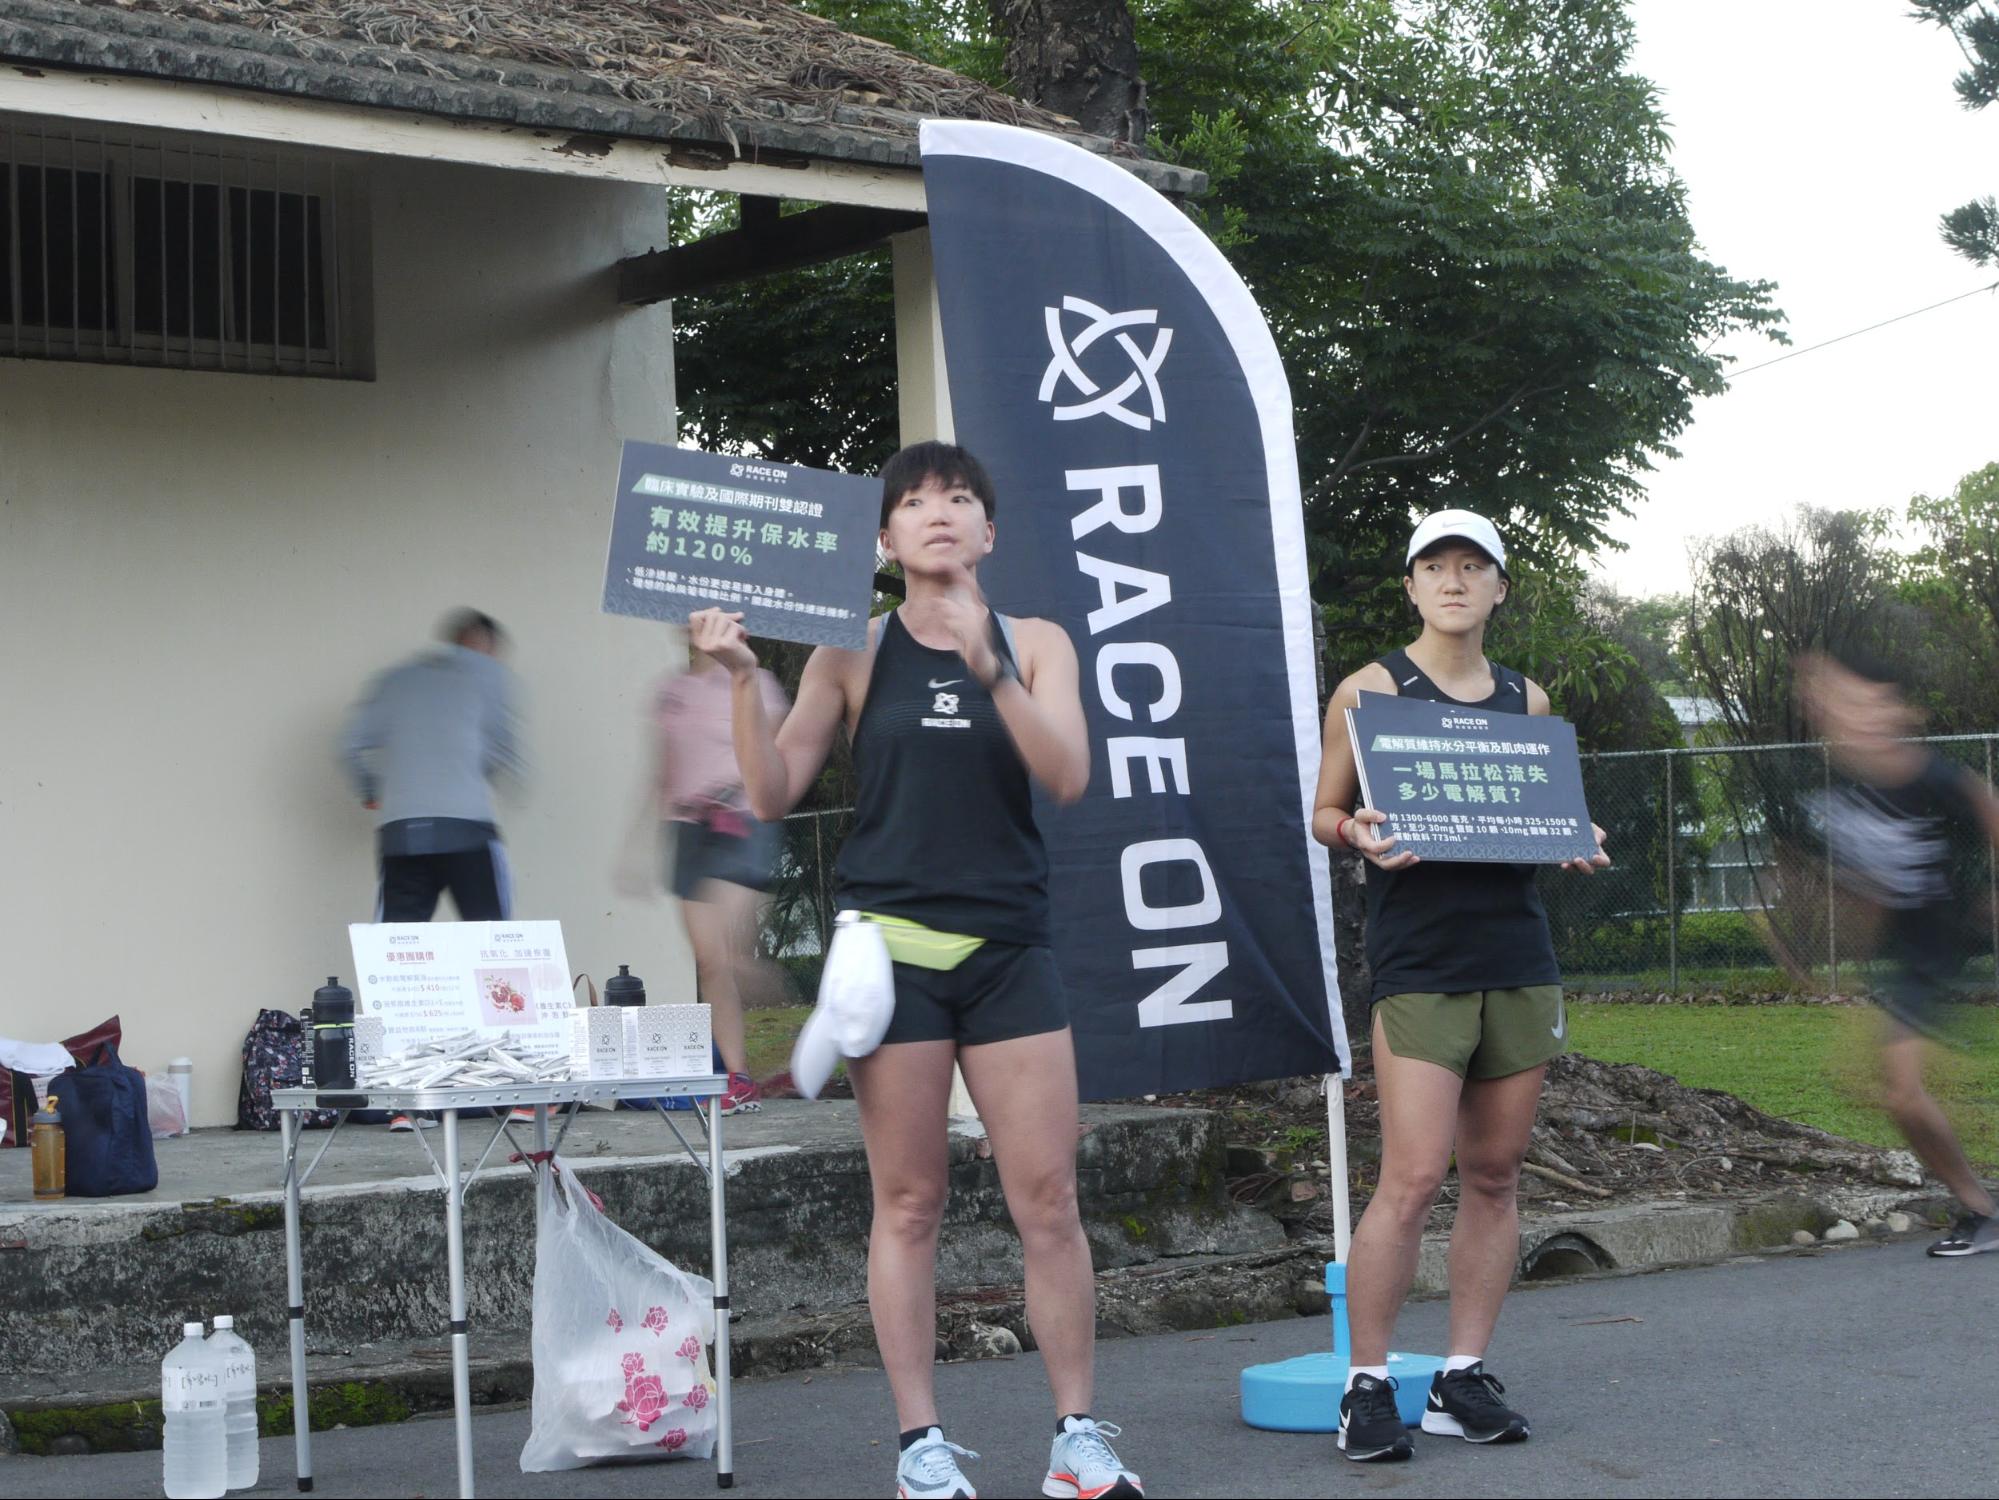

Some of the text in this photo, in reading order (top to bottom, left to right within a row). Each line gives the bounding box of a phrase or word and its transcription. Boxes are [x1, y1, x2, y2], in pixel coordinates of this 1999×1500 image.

[745, 465, 771, 477] RACE
[772, 468, 788, 479] ON
[644, 477, 824, 518] 臨床實驗及國際期刊雙認證
[650, 505, 839, 553] 有效提升保水率
[645, 531, 753, 566] 約120%
[1453, 718, 1475, 727] RACE
[1475, 719, 1489, 728] ON
[1065, 464, 1233, 1028] RACE ON
[1379, 738, 1551, 755] 電解質維持水分平衡及肌肉運作
[1392, 761, 1549, 784] 一場馬拉松流失
[1398, 782, 1521, 804] 多少電解質？
[1400, 814, 1449, 823] 1300-6000
[1524, 817, 1567, 827] 325-1500
[1429, 824, 1454, 835] 30mg
[1476, 825, 1487, 834] 10
[1550, 827, 1561, 836] 32
